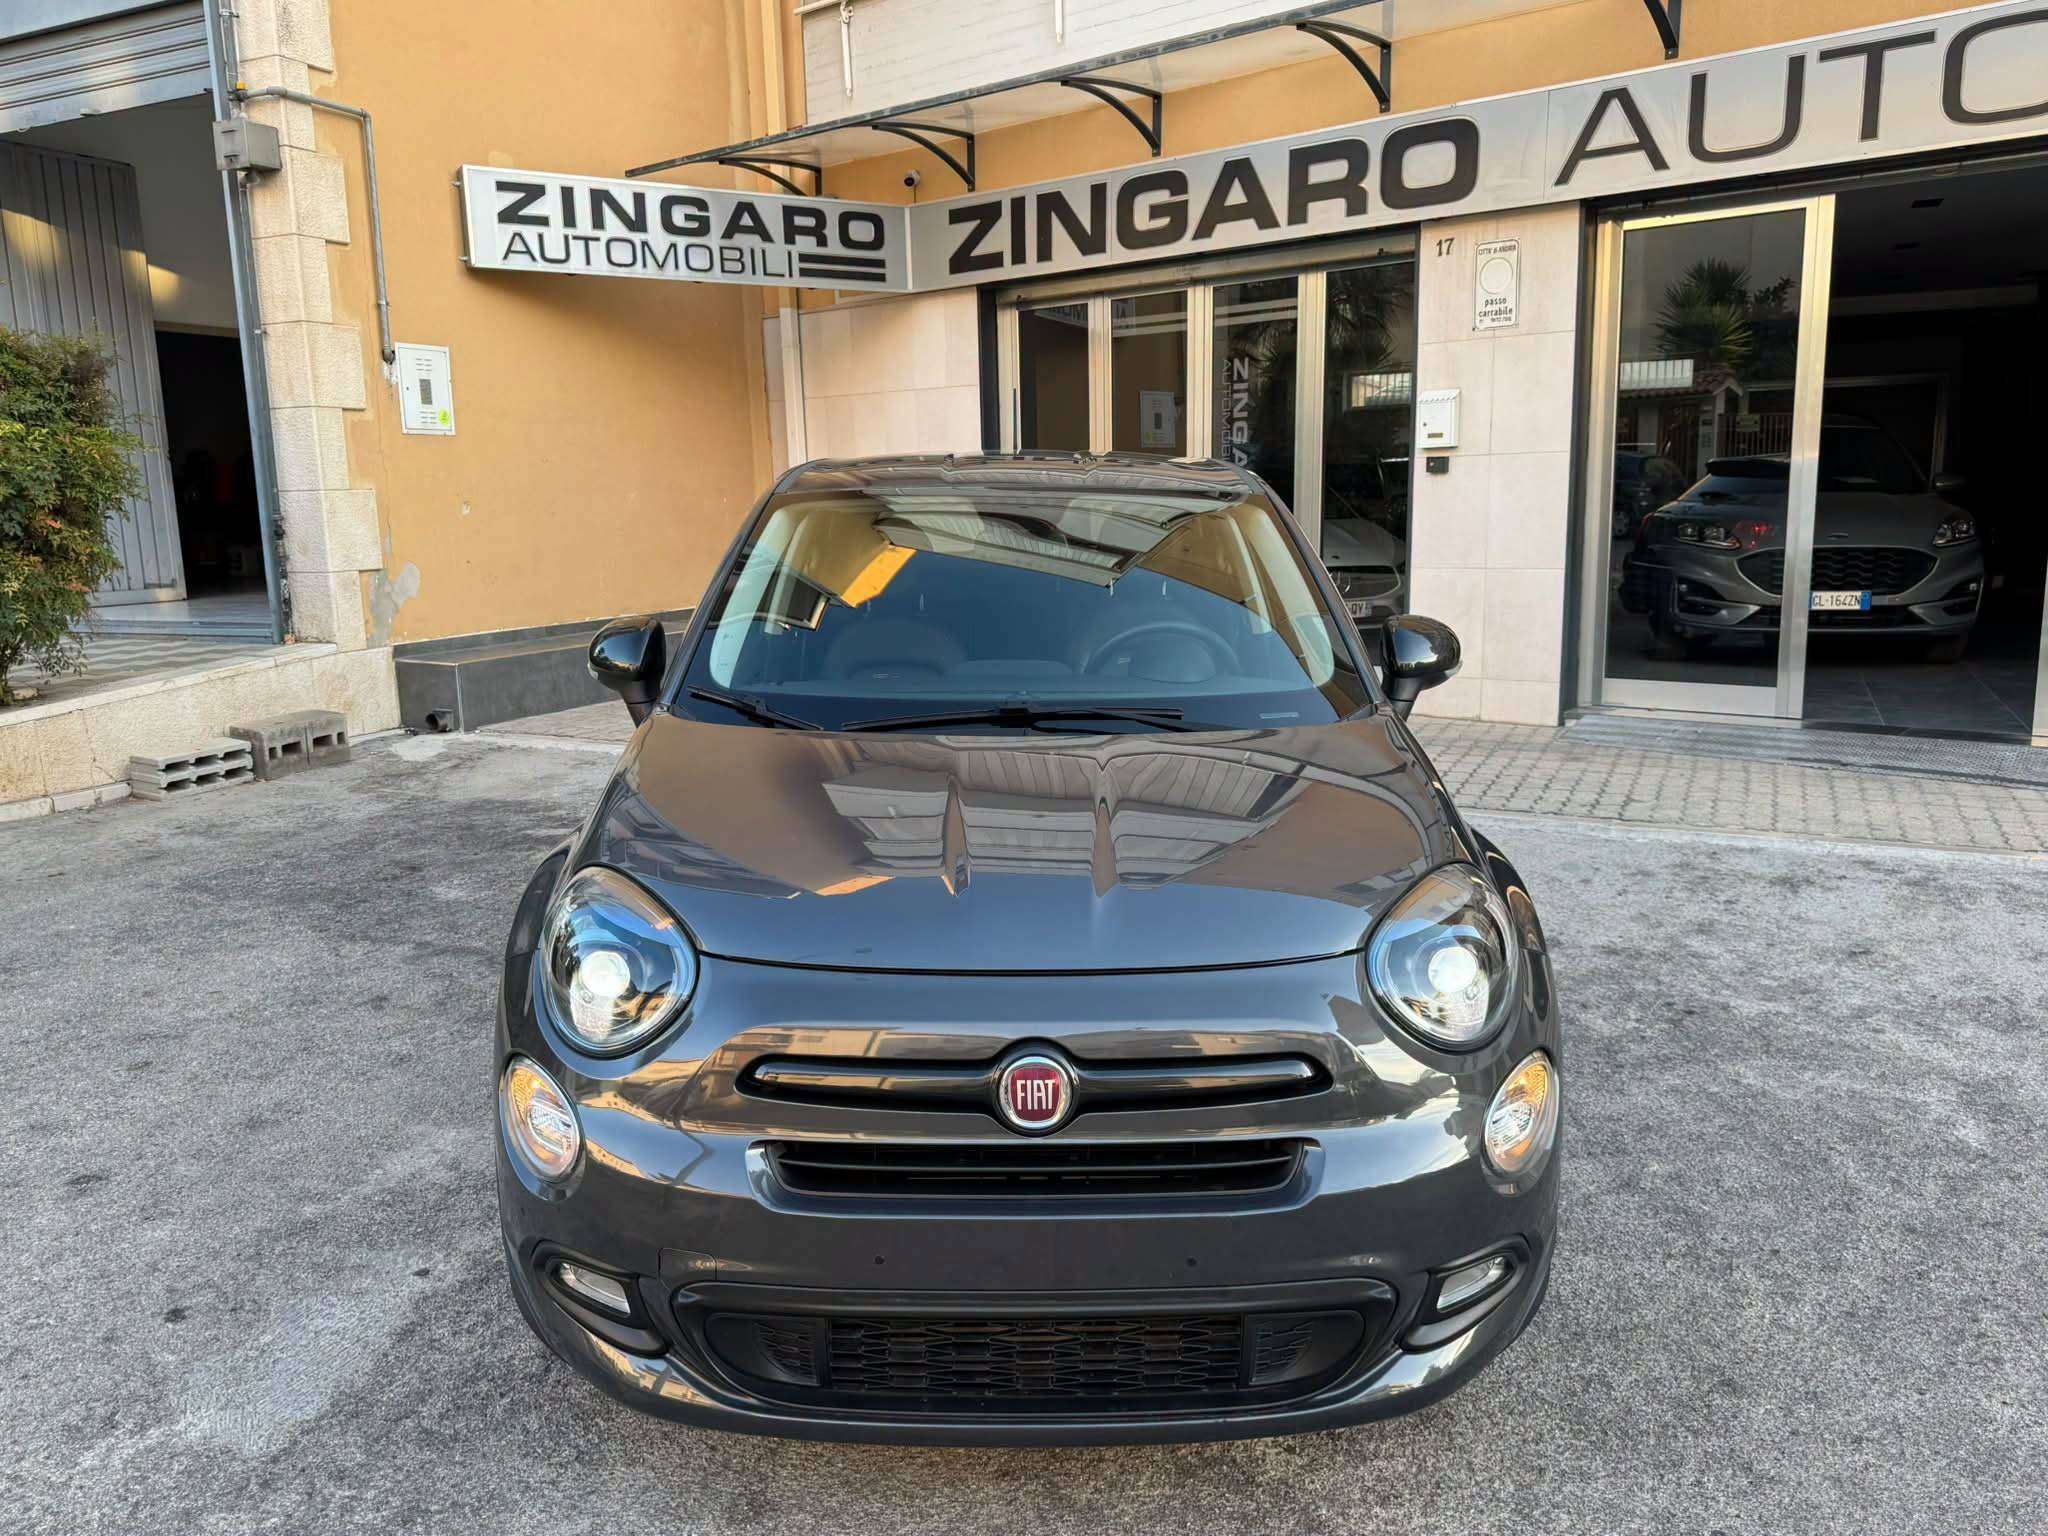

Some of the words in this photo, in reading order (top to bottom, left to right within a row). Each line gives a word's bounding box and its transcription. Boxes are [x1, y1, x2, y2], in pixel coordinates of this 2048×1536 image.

[496, 181, 885, 251] ZINGARO
[949, 118, 1479, 275] ZINGARO
[502, 232, 796, 279] AUTOMOBILI
[1436, 237, 1455, 256] 17
[1479, 306, 1513, 318] carrabile
[1485, 297, 1507, 307] passo
[1222, 359, 1231, 461] AUTOMOBI
[1233, 357, 1249, 467] ZINGA
[1016, 1079, 1056, 1111] FIAT
